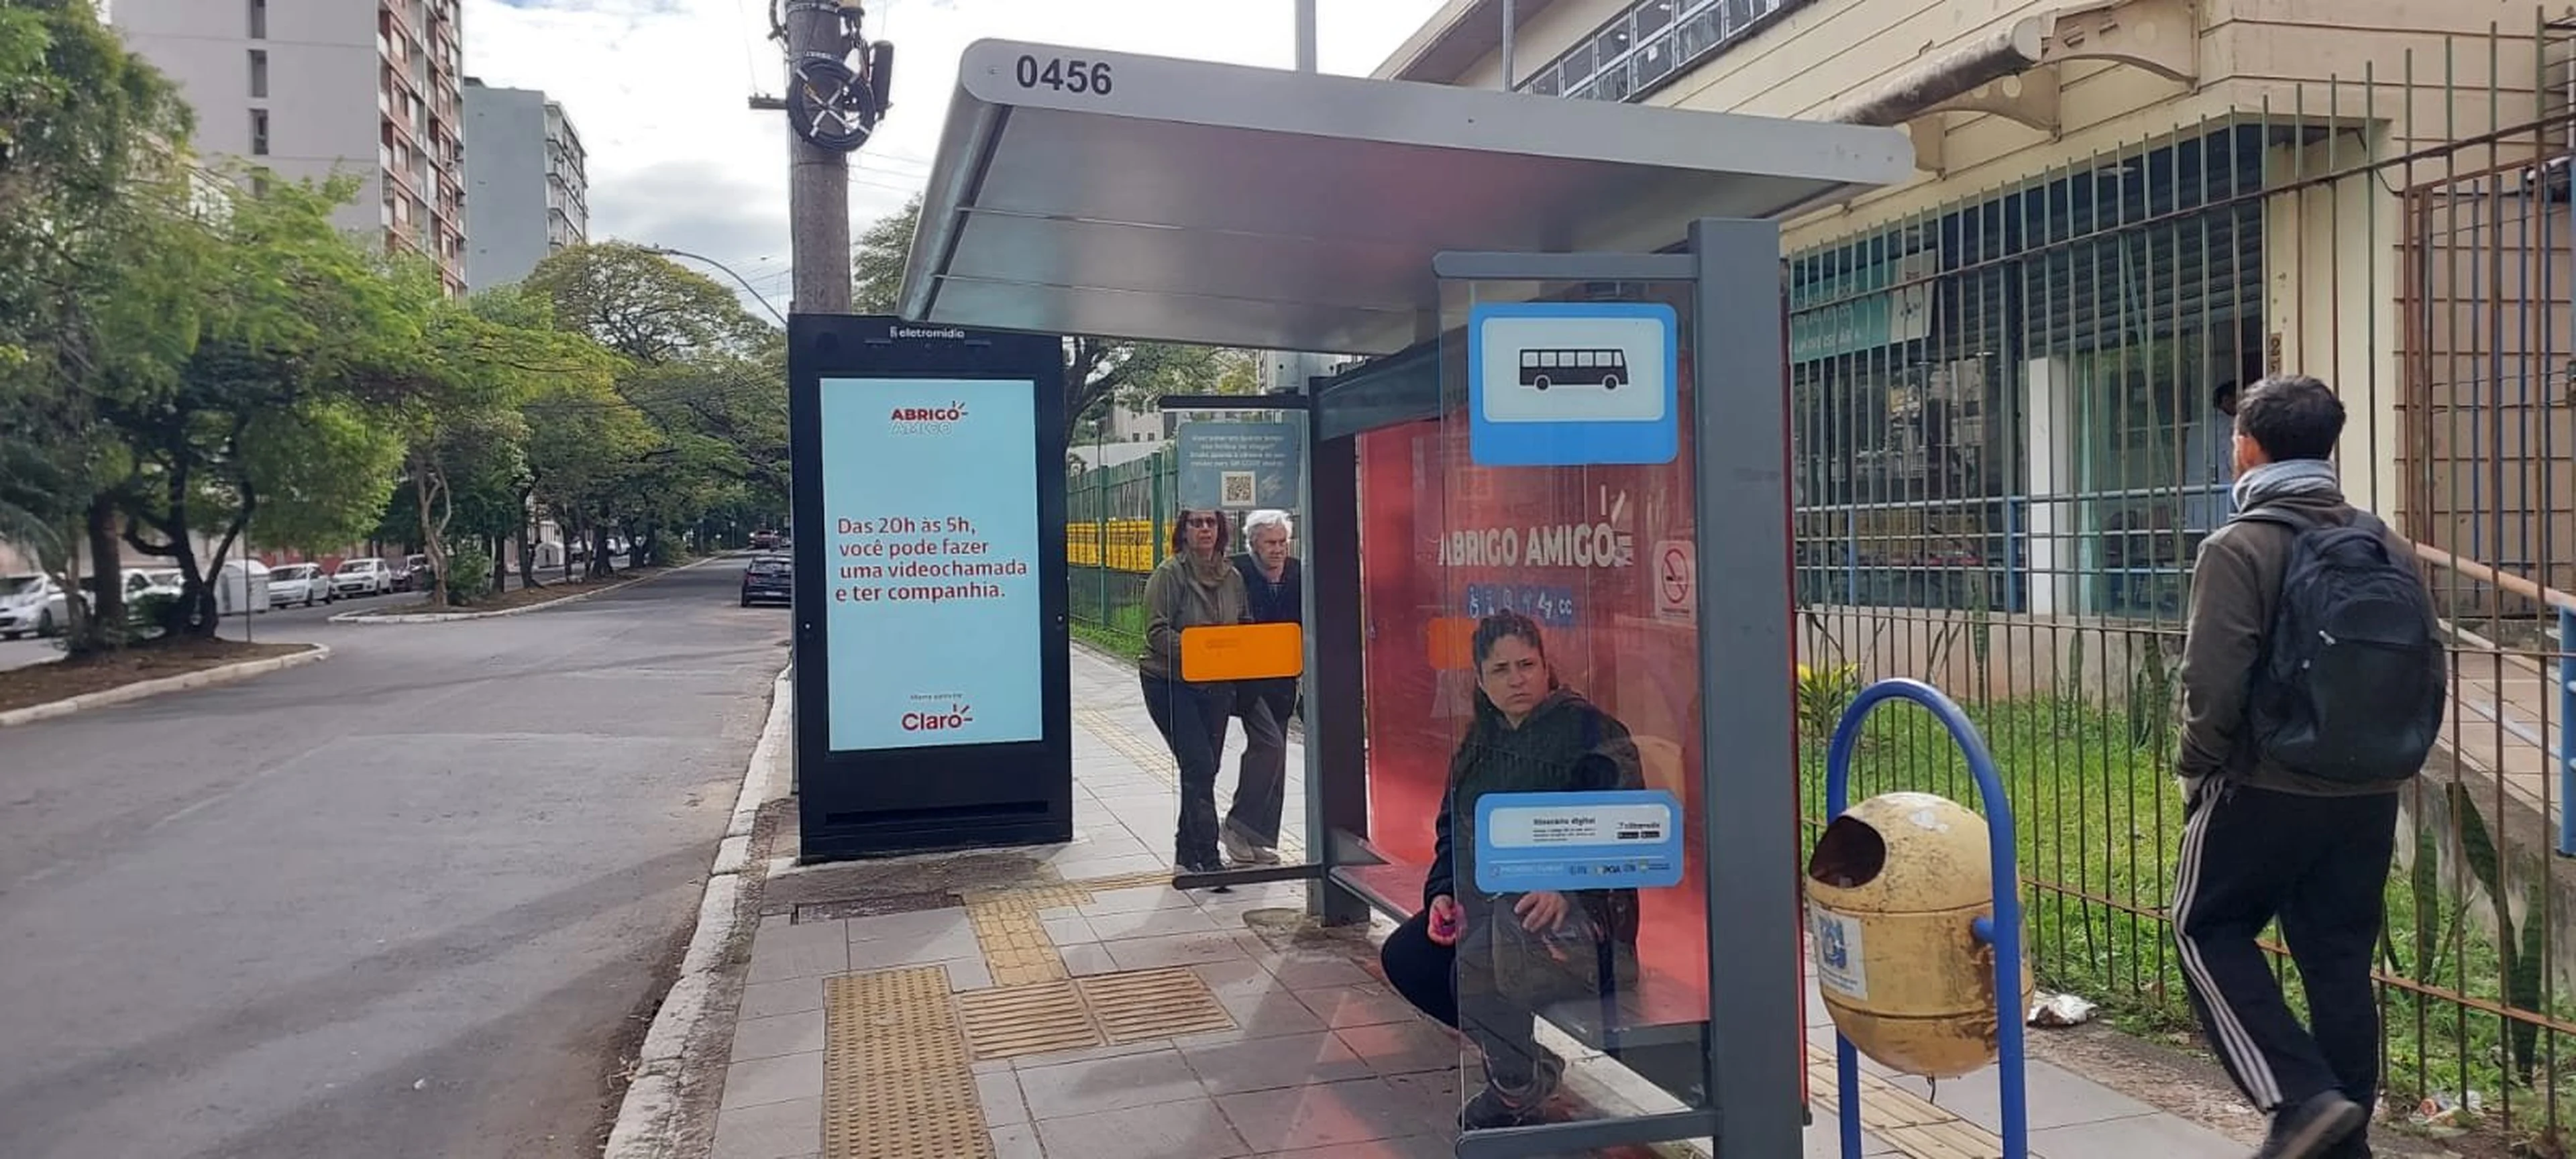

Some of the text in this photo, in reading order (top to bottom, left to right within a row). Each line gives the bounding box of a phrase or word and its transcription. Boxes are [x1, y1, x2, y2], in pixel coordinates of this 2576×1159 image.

[1017, 54, 1112, 95] 0456
[892, 408, 960, 421] ABRIGO
[838, 516, 976, 535] Das 20h às 5h,
[839, 538, 989, 559] você pode fazer
[1438, 527, 1518, 567] ABRIGO
[1524, 522, 1615, 567] AMIGO
[840, 559, 1028, 579] uma videochamada
[835, 582, 1006, 604] e ter companhia.
[902, 712, 963, 731] Claro
